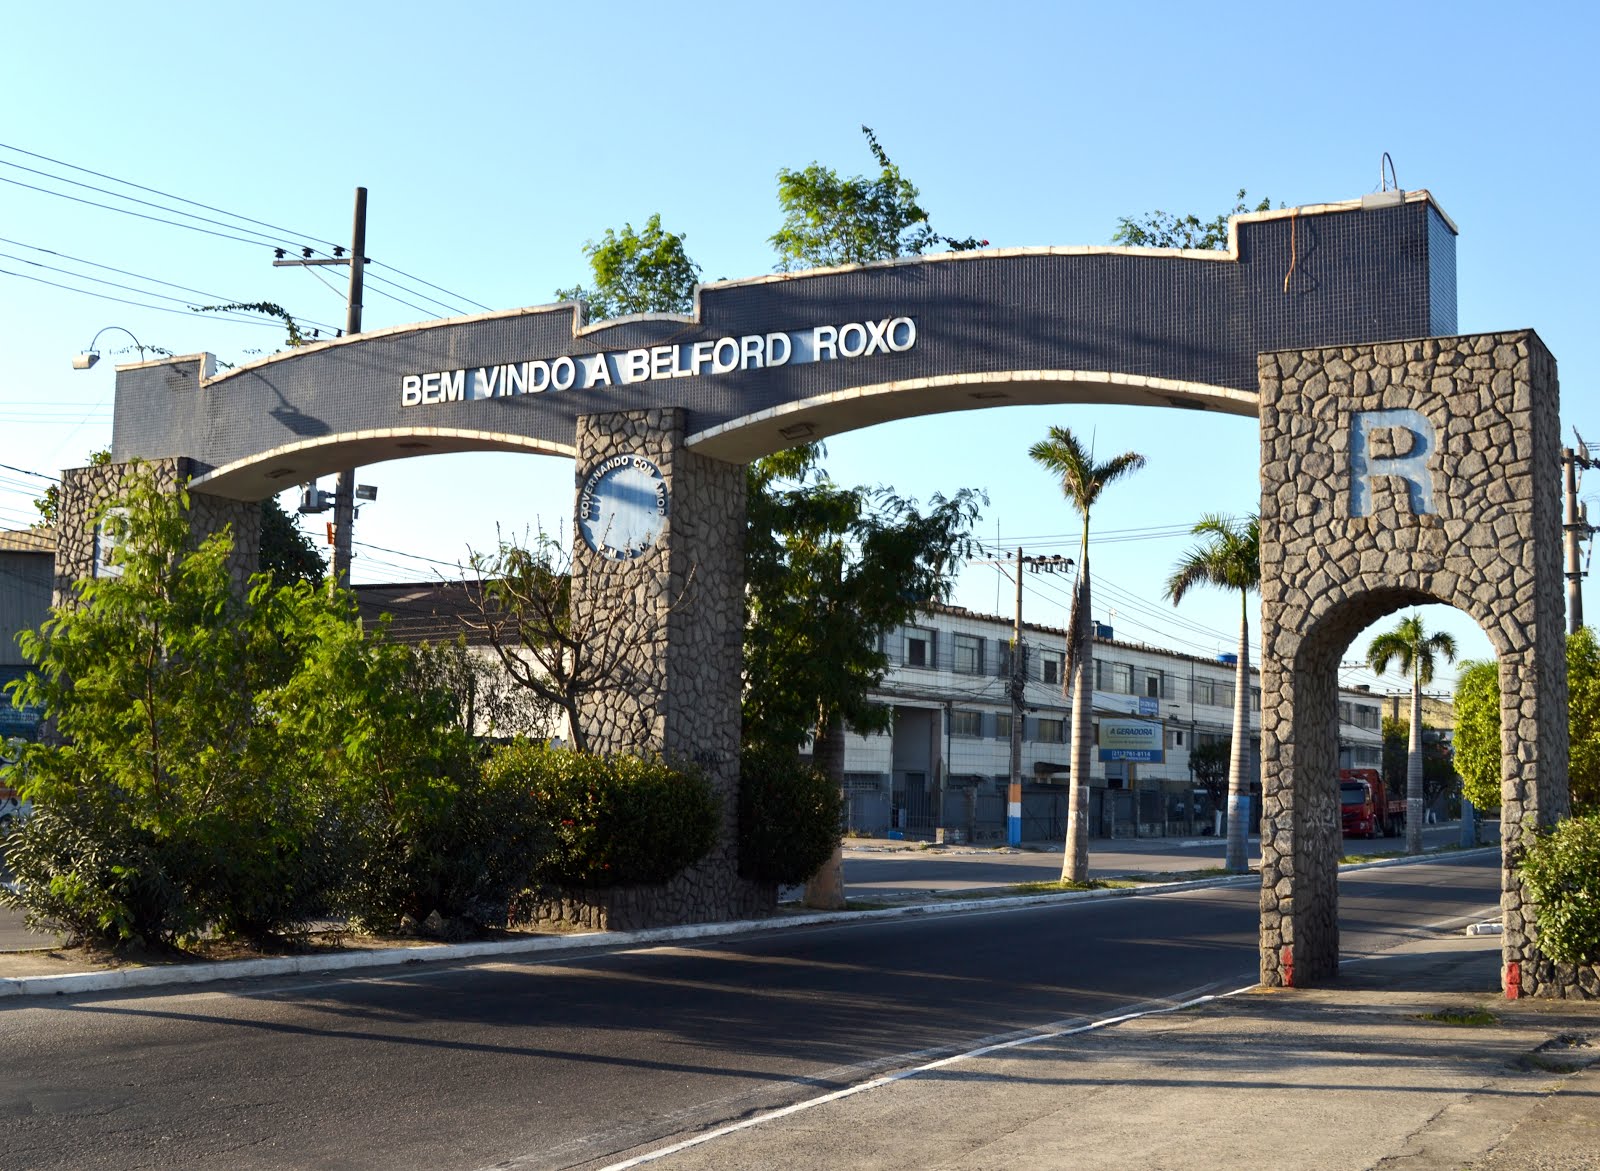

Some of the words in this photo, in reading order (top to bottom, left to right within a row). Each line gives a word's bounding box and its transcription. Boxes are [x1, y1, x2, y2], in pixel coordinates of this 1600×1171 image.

[401, 369, 465, 406] BEM
[478, 355, 576, 399] VINDO
[587, 353, 612, 387] A
[627, 331, 792, 383] BELFORD
[813, 316, 917, 361] ROXO
[580, 455, 629, 520] GOVERNANDO
[633, 457, 655, 477] COM
[1350, 409, 1438, 518] R
[1116, 728, 1152, 736] GERADORA
